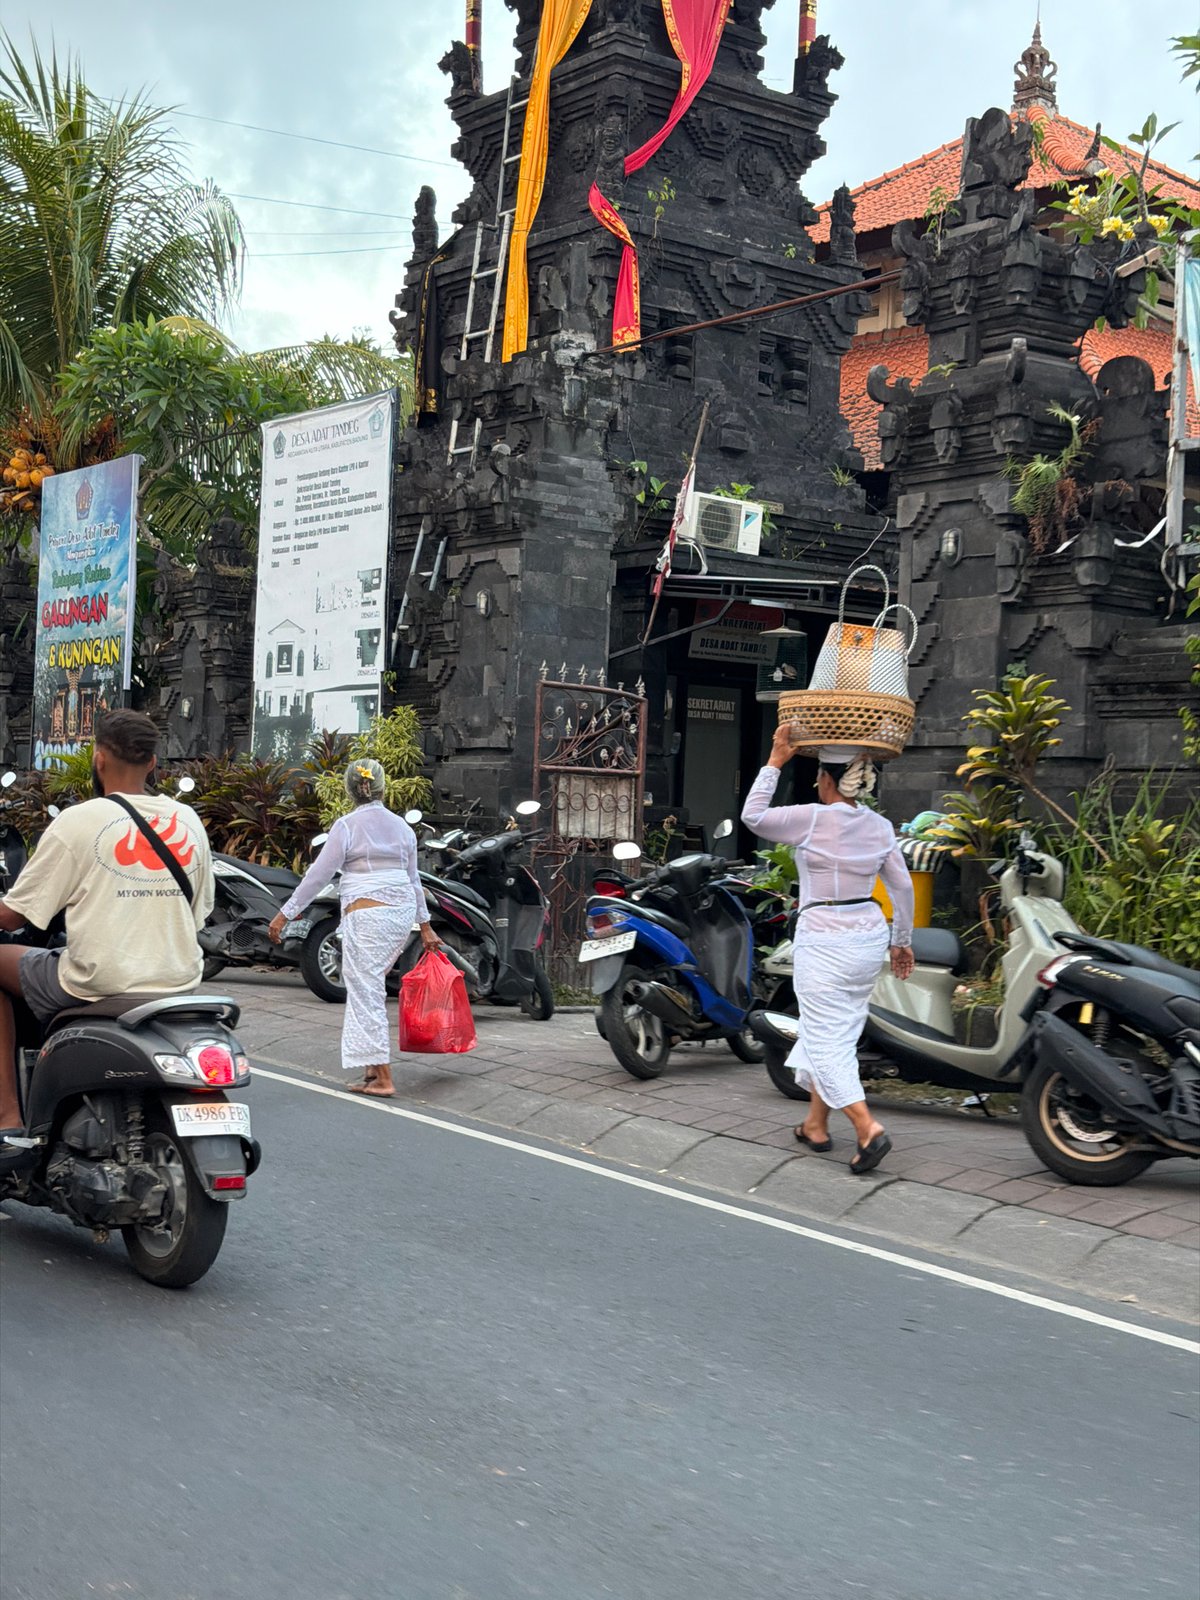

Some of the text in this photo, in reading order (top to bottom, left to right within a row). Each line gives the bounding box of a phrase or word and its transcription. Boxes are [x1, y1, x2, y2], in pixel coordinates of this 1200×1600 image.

[291, 430, 310, 448] DESA
[42, 592, 109, 631] GALUNGAN
[700, 638, 719, 649] DESA
[49, 635, 121, 670] & KUNINGAN
[116, 889, 131, 898] MY
[132, 889, 153, 898] OWN
[195, 1105, 227, 1121] 4986
